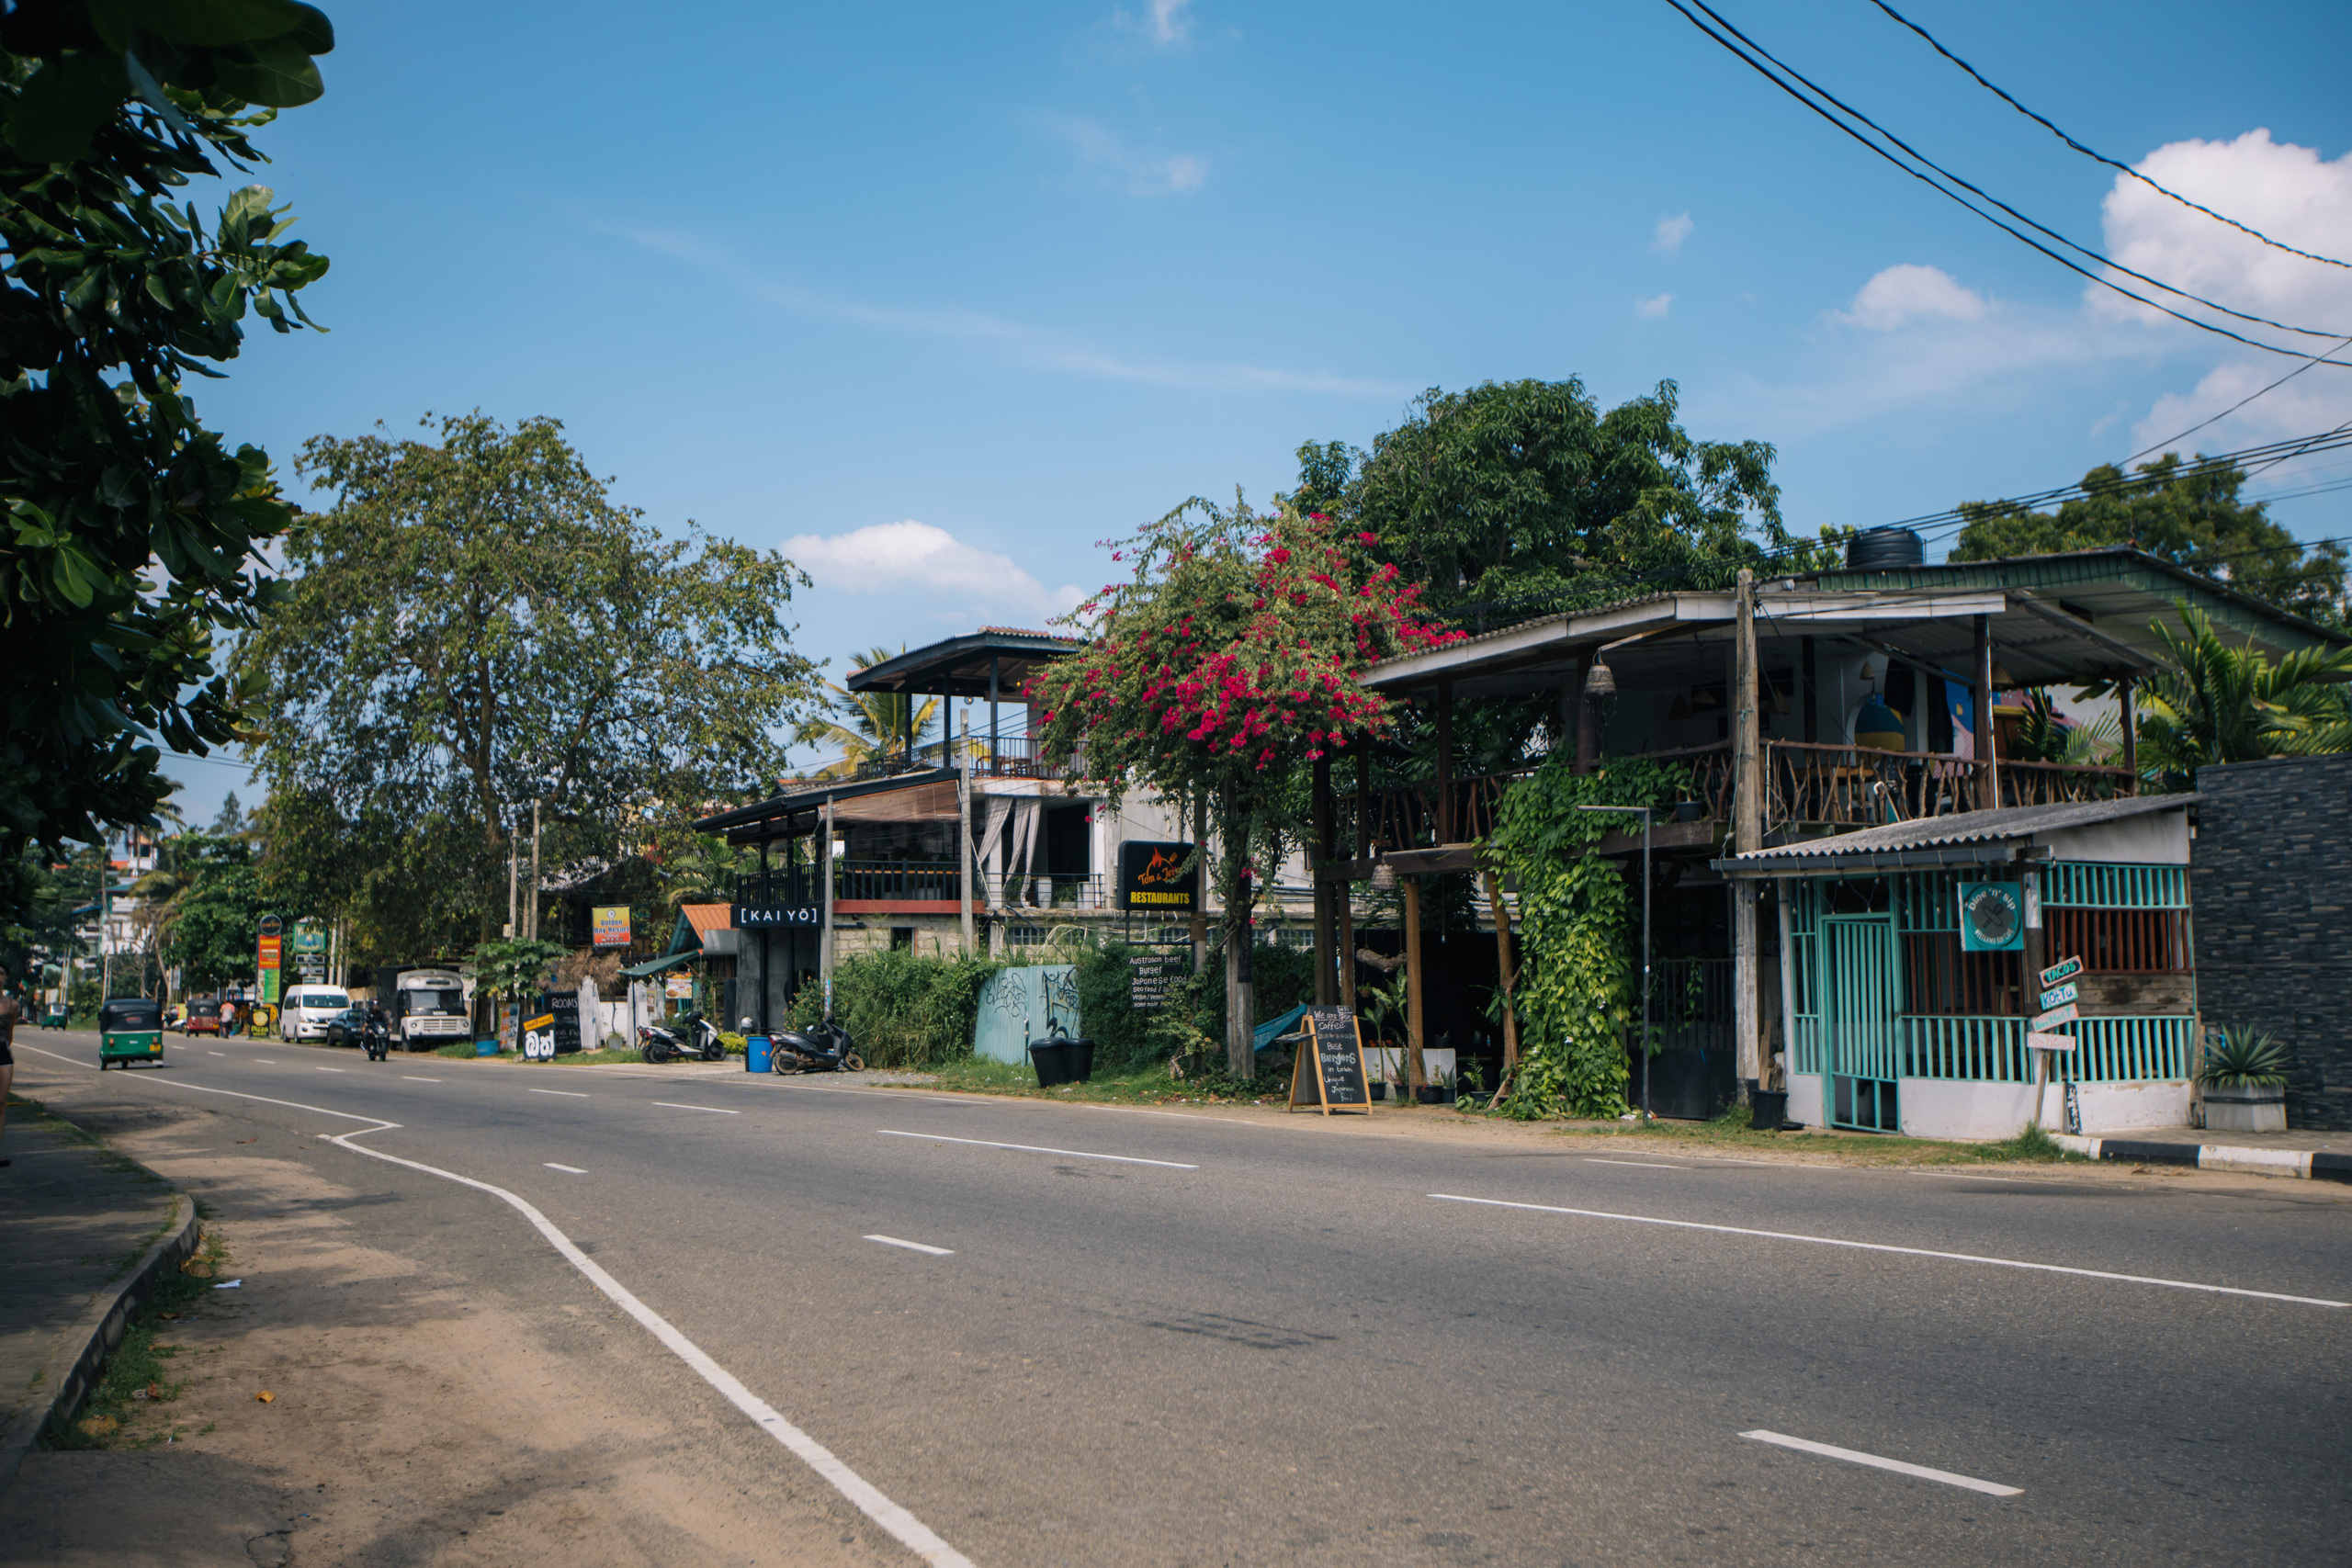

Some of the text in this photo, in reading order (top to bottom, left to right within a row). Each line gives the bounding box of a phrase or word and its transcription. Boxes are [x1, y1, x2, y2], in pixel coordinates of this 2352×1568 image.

[1137, 872, 1156, 886] Tom
[1156, 873, 1162, 881] &
[1130, 891, 1190, 904] RESTAURANTS
[1968, 890, 1987, 911] Dine
[2002, 892, 2016, 910] Sip
[1129, 955, 1182, 965] Australian beef
[1139, 965, 1163, 975] Burger
[2044, 961, 2076, 983] TACOS
[1170, 974, 1187, 984] food
[551, 997, 579, 1010] ROOMS
[1314, 1010, 1326, 1020] We
[1318, 1021, 1346, 1030] Coffee
